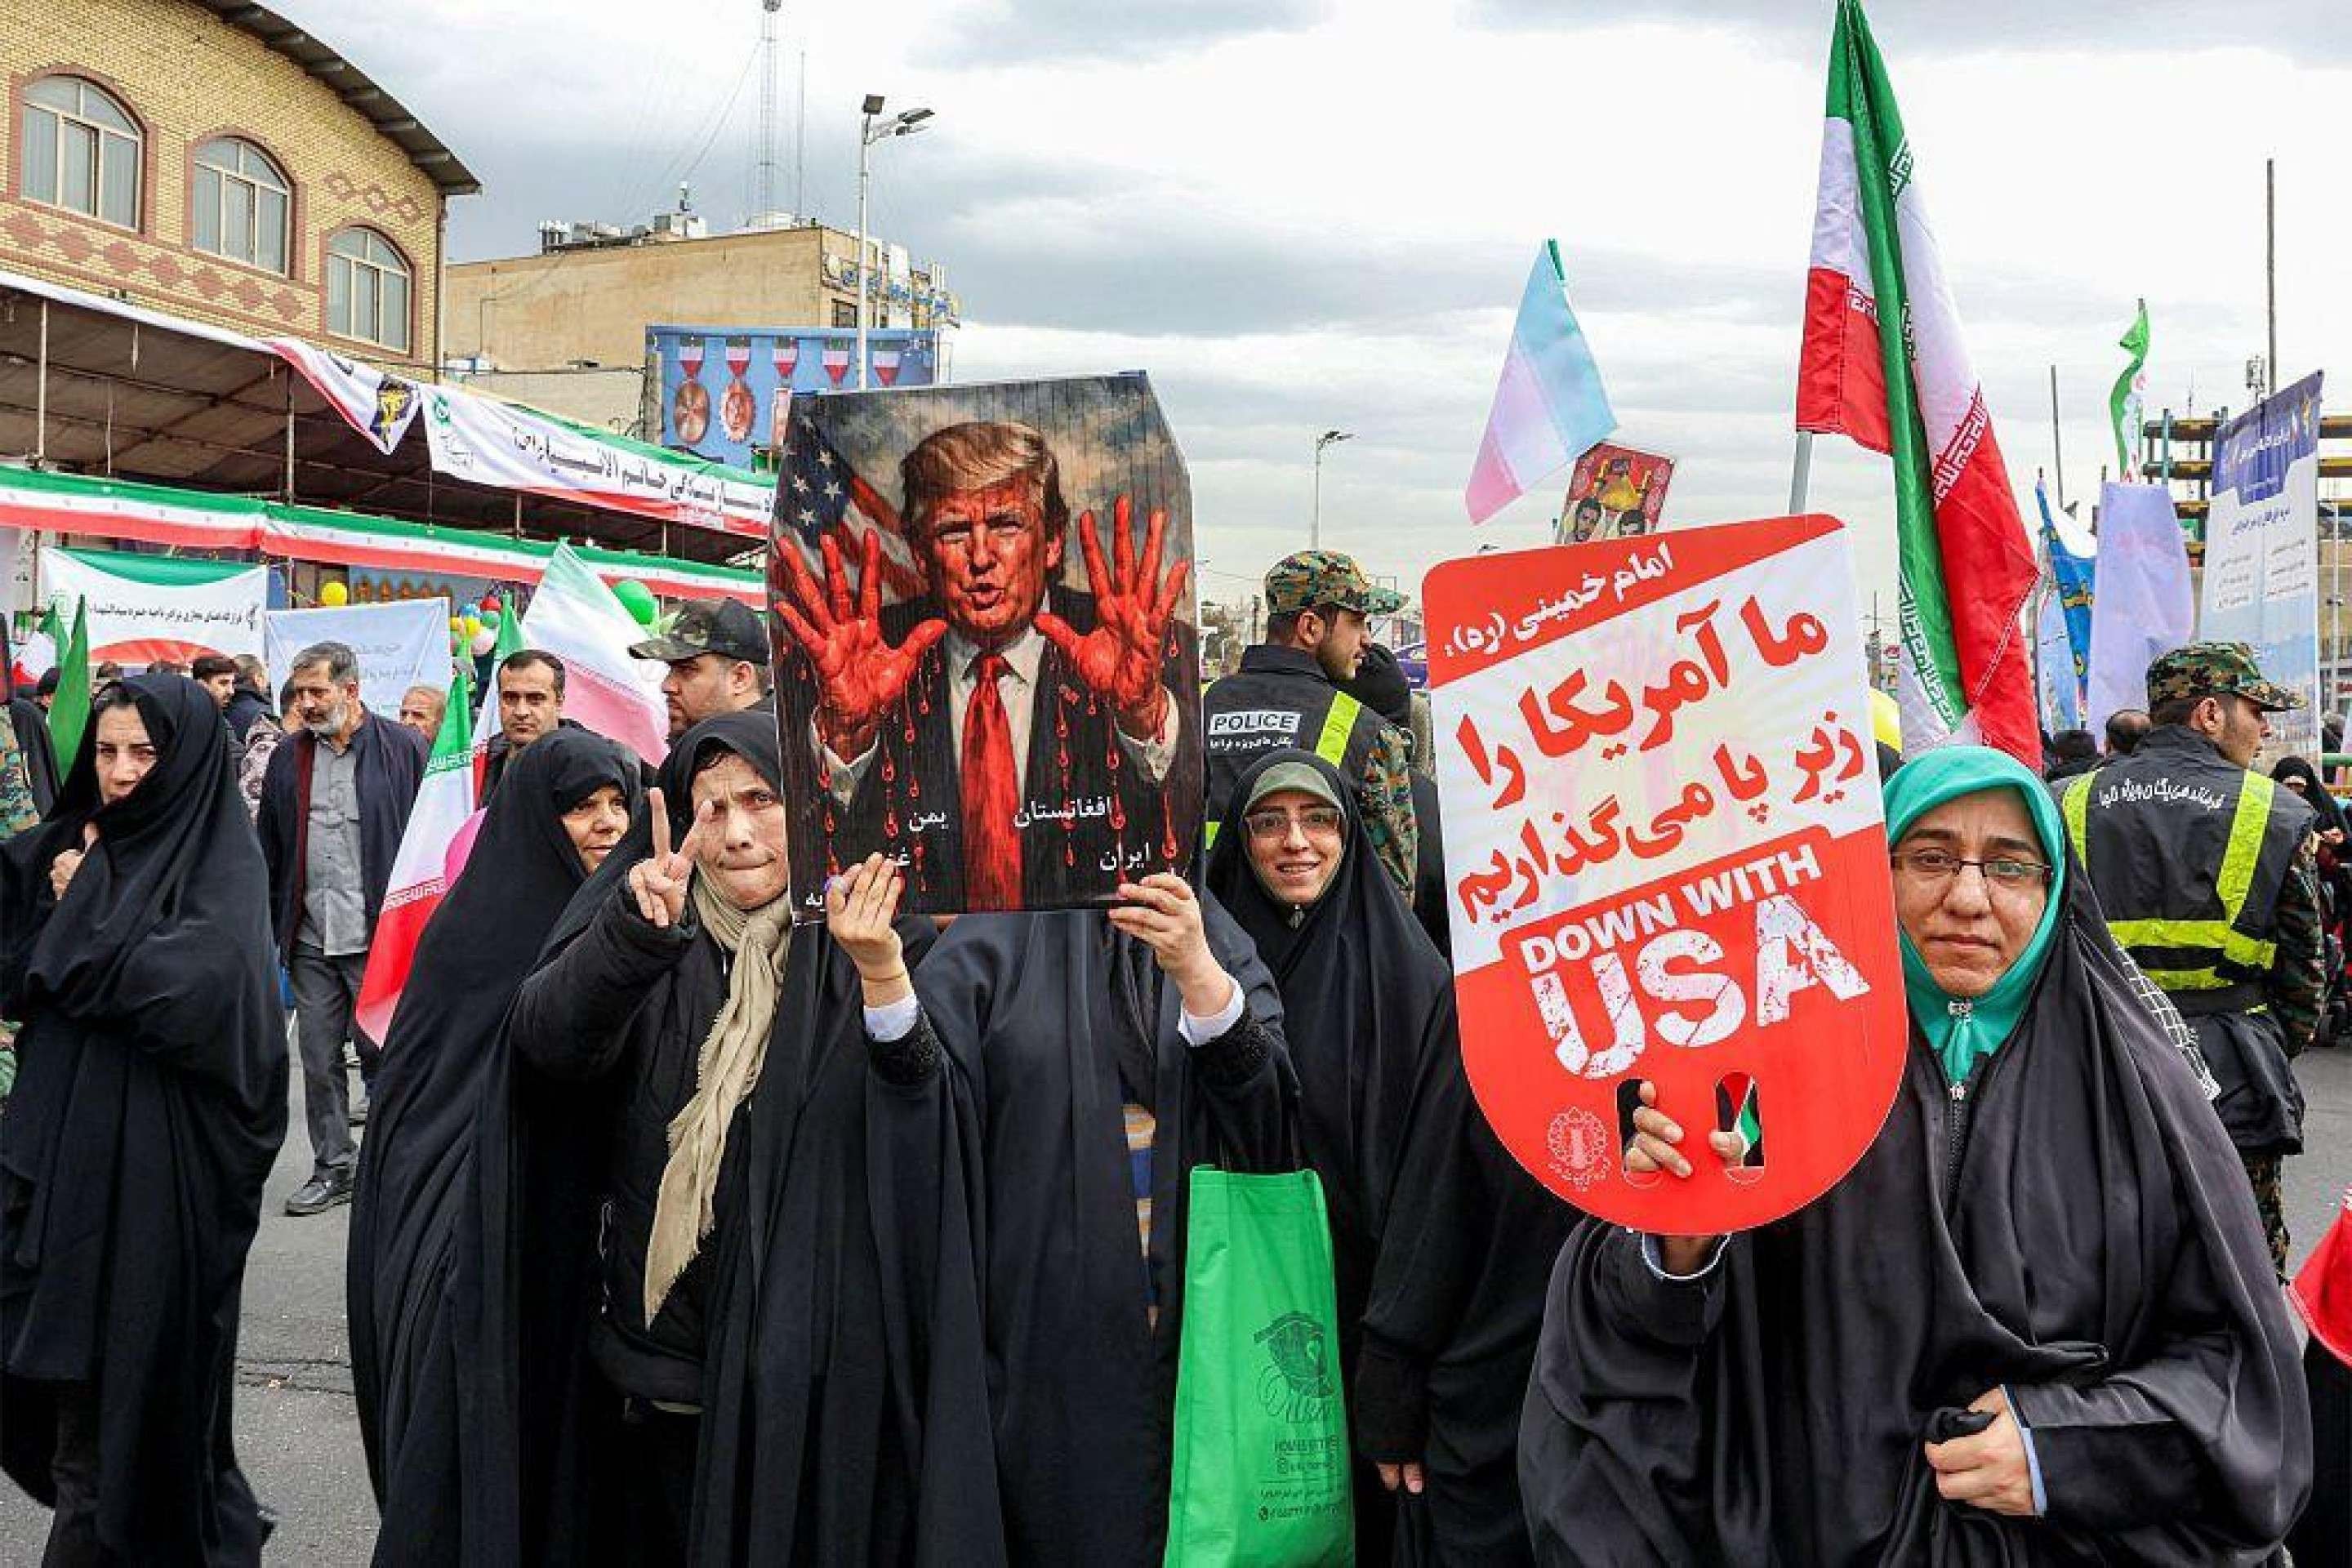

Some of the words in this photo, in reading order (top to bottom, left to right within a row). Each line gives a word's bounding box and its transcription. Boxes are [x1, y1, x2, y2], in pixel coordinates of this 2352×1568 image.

[1513, 572, 1606, 641] خمینی
[1614, 541, 1673, 603] امام
[1740, 595, 1829, 667] ما
[1518, 599, 1729, 761] آمریکا
[1214, 712, 1296, 731] POLICE
[1793, 710, 1865, 804] زیر
[1456, 713, 1526, 811] را
[1713, 742, 1770, 826] پا
[908, 810, 949, 832] یمن
[1013, 795, 1111, 828] افغانستان
[1098, 841, 1151, 871] ایران
[1520, 892, 1678, 974] DOWN
[1681, 844, 1823, 918] WITH
[1530, 893, 1871, 1080] USA
